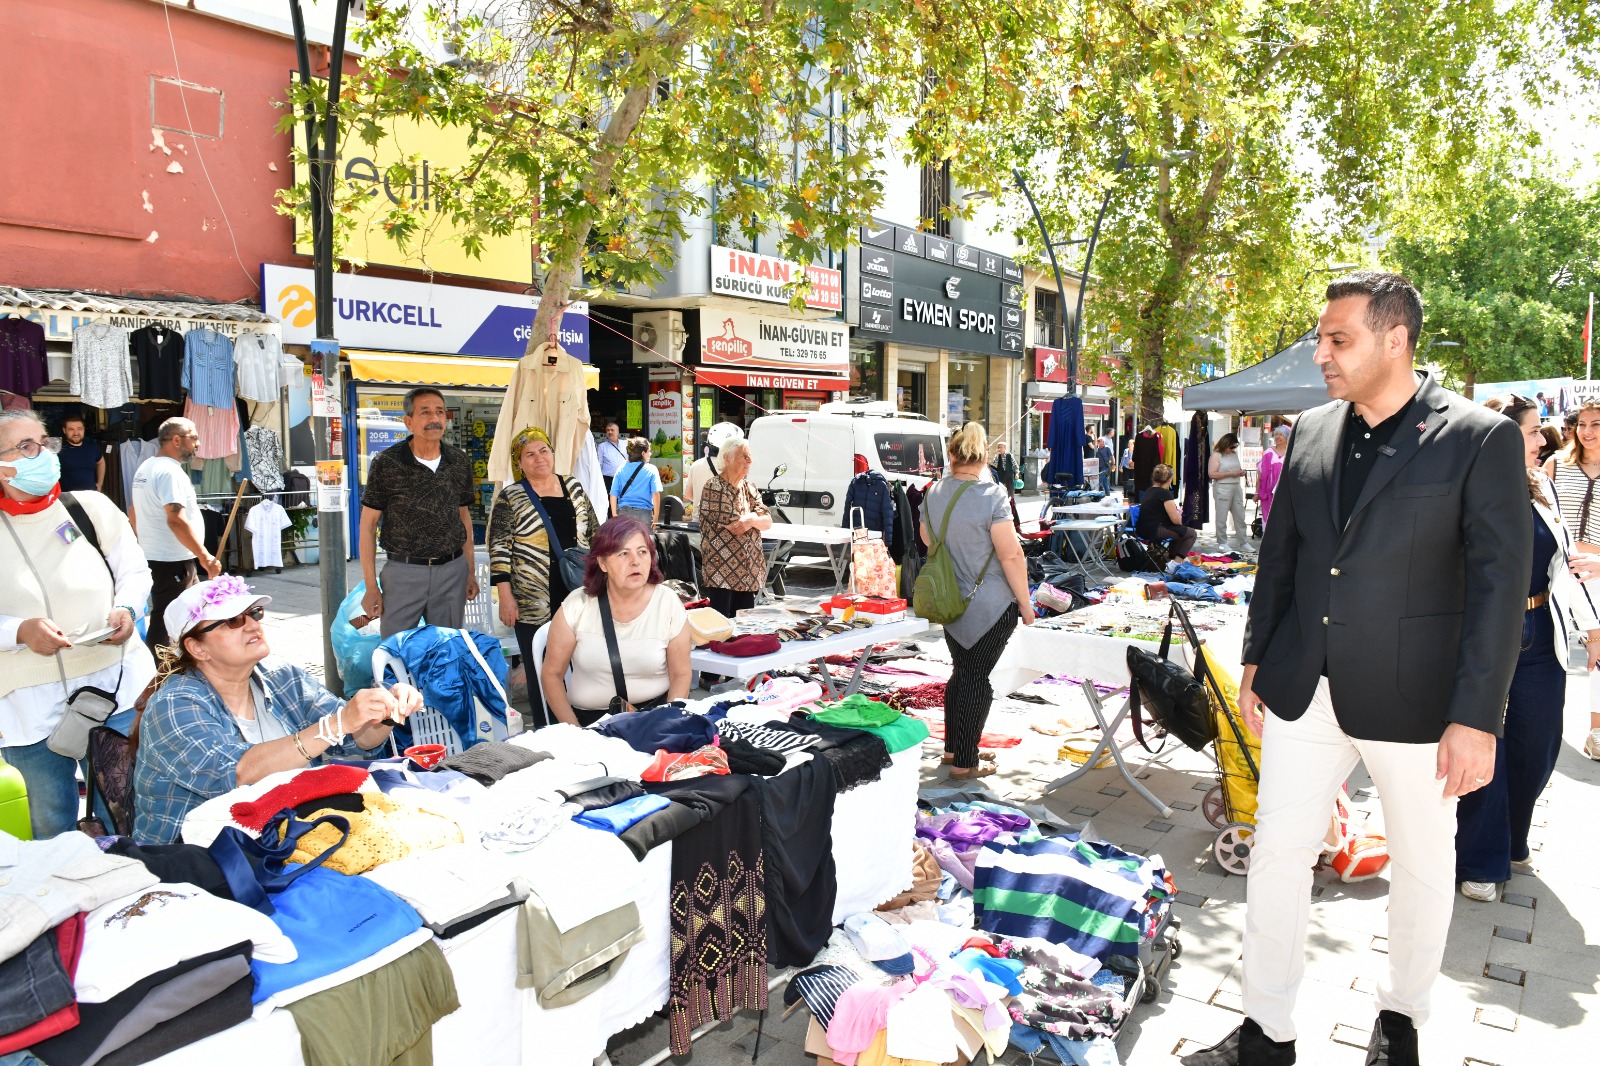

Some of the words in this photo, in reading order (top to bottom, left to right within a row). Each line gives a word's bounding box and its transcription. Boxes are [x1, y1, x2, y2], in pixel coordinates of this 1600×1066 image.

[715, 275, 762, 295] SÜRÜCÜ
[820, 272, 829, 286] 22
[830, 275, 839, 288] 00
[820, 290, 829, 303] 20
[830, 292, 839, 305] 55
[903, 298, 953, 328] EYMEN
[959, 308, 996, 334] SPOR
[759, 319, 828, 346] İNAN-GÜVEN
[831, 331, 844, 347] ET
[780, 347, 795, 358] TEL:
[796, 348, 809, 359] 329
[810, 350, 818, 360] 76
[746, 373, 771, 388] İNAN
[773, 376, 804, 389] GÜVEN
[807, 379, 819, 389] ET
[369, 431, 378, 439] 20
[379, 431, 389, 439] GB
